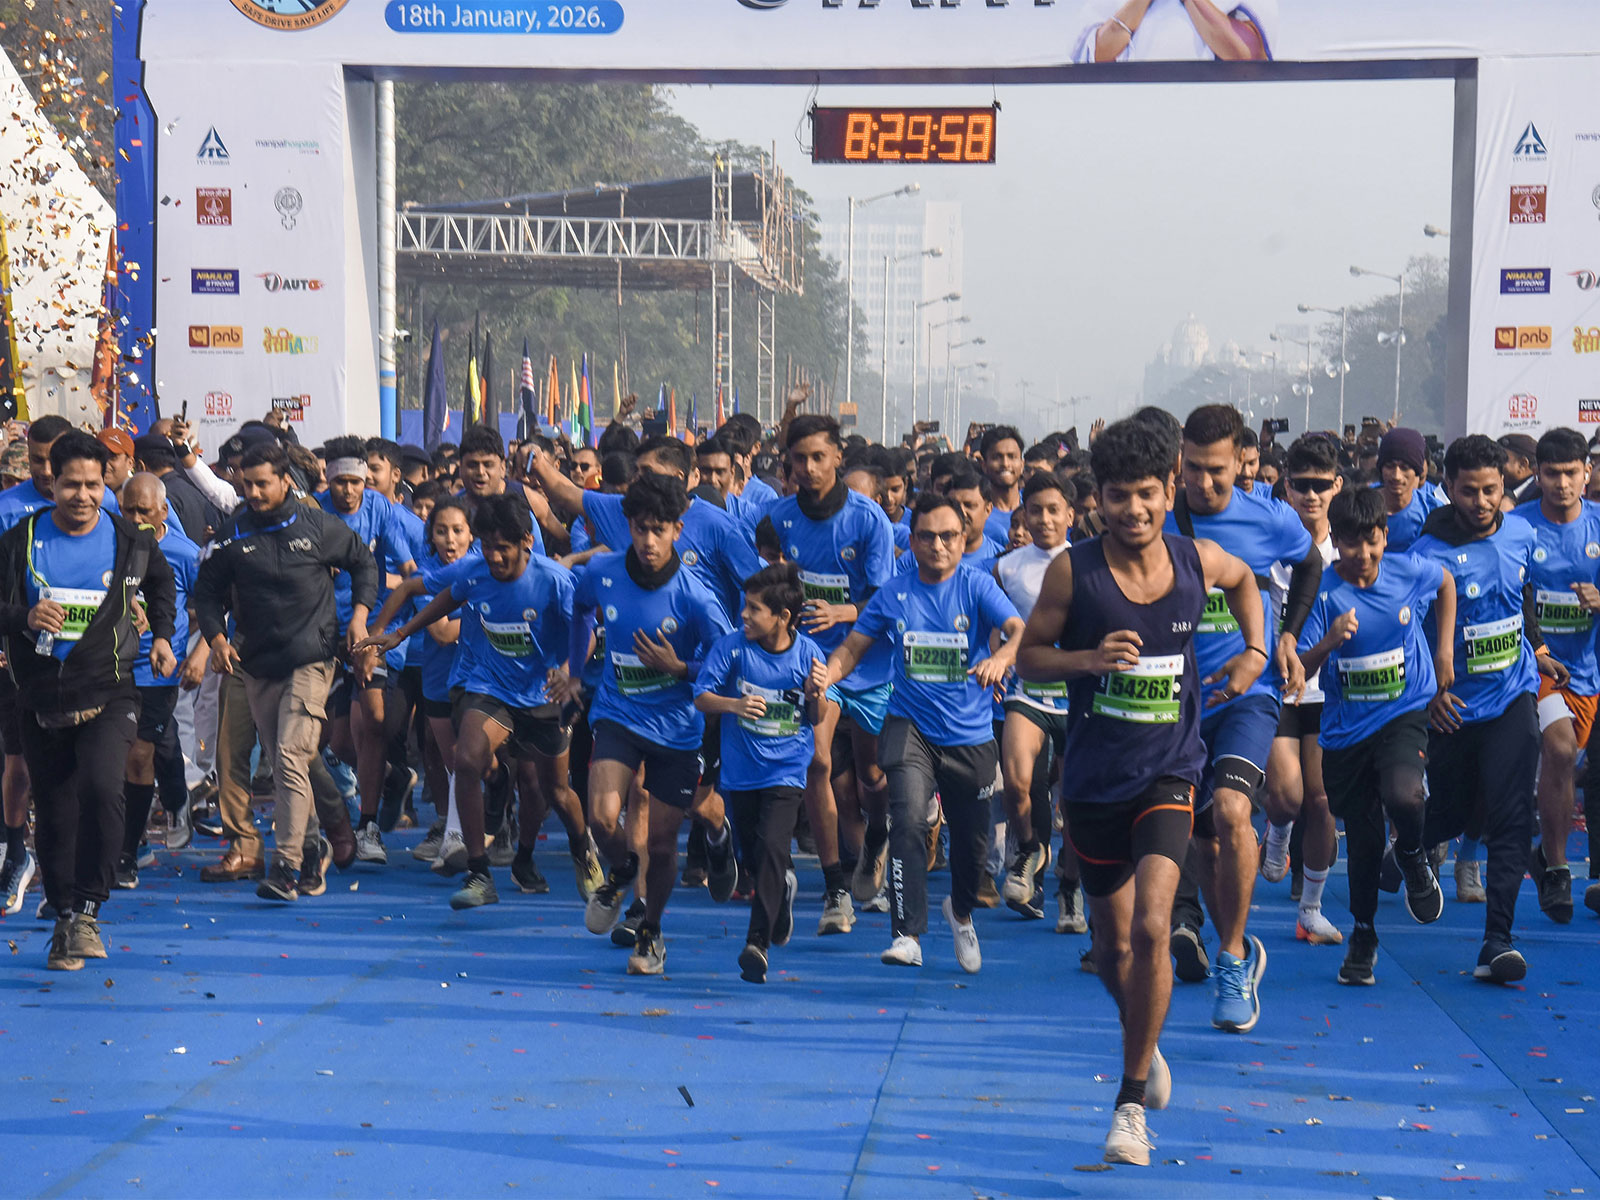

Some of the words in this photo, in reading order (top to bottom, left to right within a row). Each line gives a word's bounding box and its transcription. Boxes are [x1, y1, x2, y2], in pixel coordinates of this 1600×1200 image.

[242, 3, 262, 20] SAFE
[265, 16, 292, 28] DRIVE
[294, 15, 317, 27] SAVE
[317, 3, 336, 20] LIFE
[398, 3, 445, 27] 18th
[451, 4, 541, 33] January,
[547, 5, 606, 28] 2026.
[844, 113, 992, 161] 8:29:58
[212, 328, 240, 347] pnb
[1519, 327, 1549, 348] pnb
[205, 393, 233, 409] RED
[1508, 395, 1538, 413] RED
[63, 606, 96, 623] 646
[1171, 621, 1192, 633] ZARA
[1475, 632, 1516, 660] 54063
[1110, 675, 1171, 700] 54263
[892, 857, 903, 882] JACK
